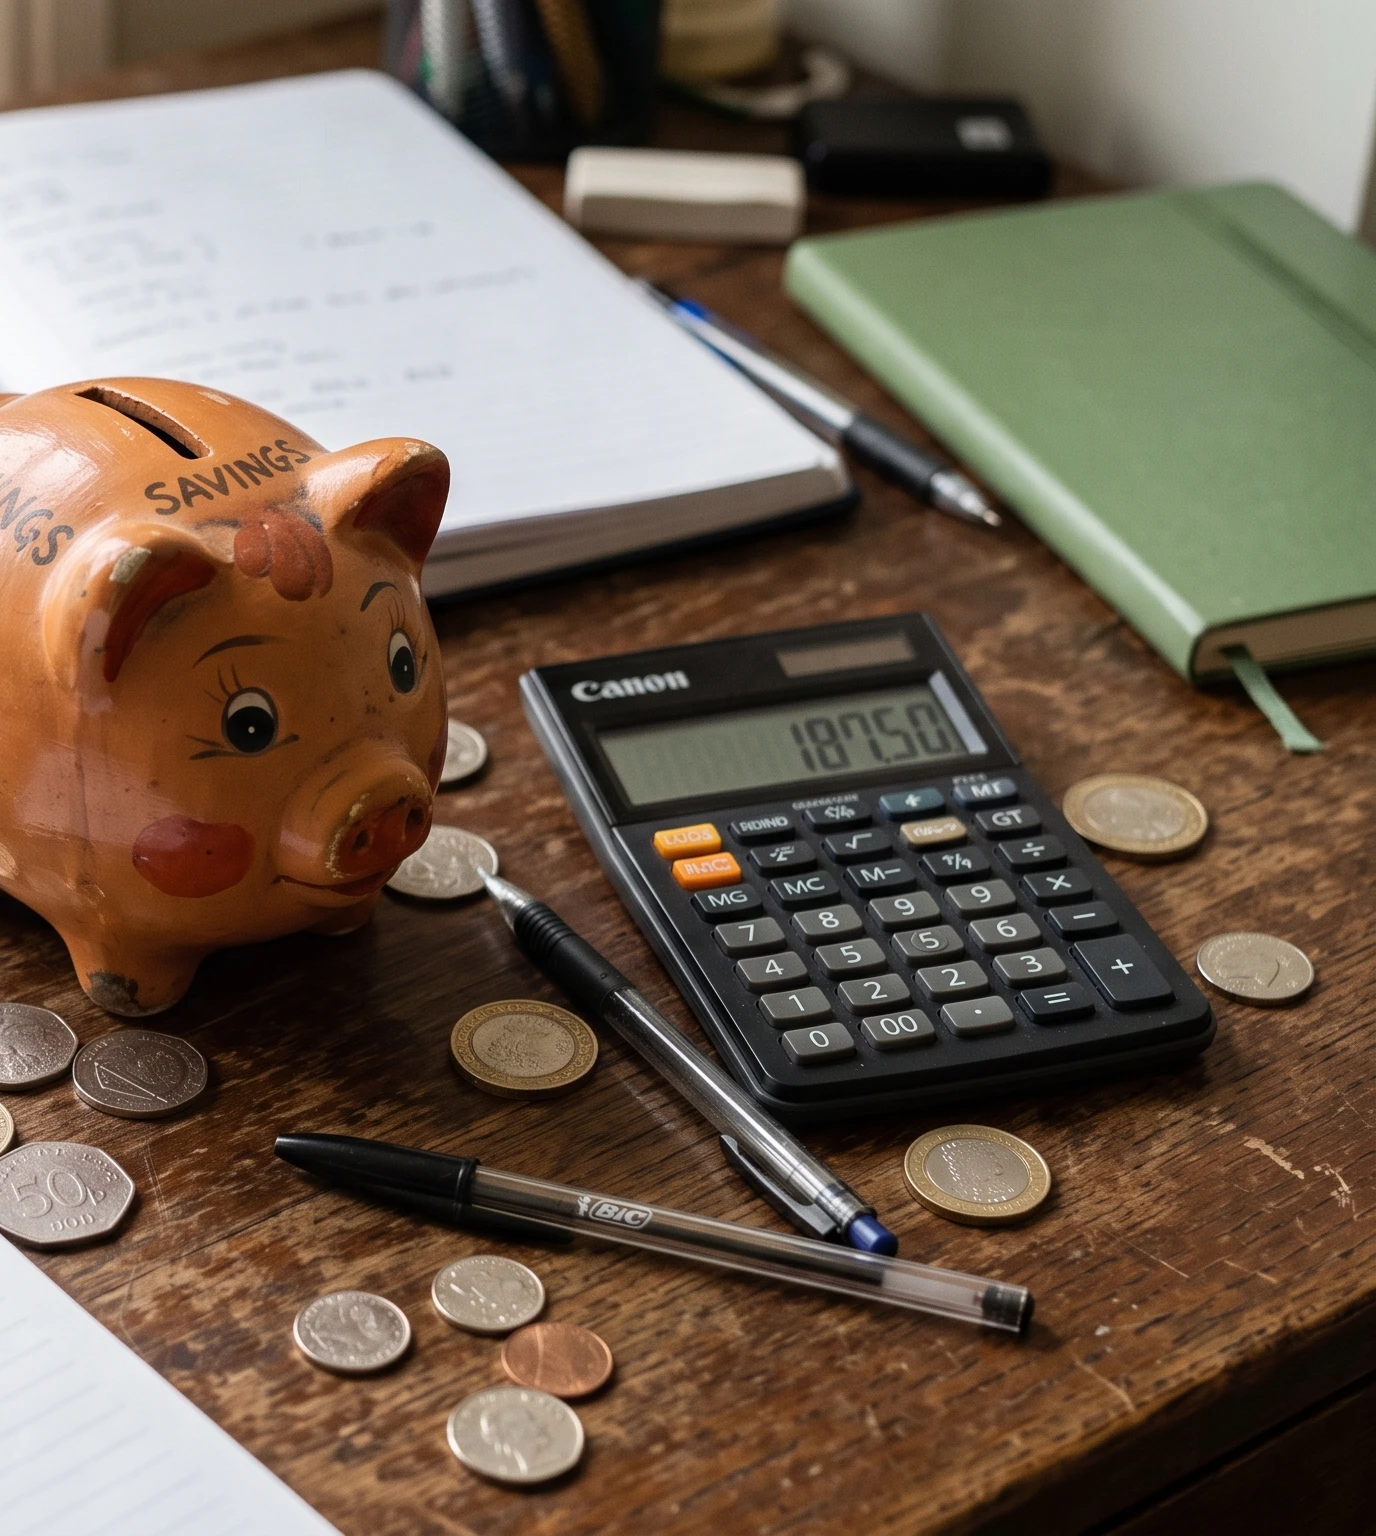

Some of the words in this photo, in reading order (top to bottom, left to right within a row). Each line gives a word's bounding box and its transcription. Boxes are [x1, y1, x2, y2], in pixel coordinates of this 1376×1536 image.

[144, 438, 312, 516] SAVINGS
[571, 669, 690, 703] Canon
[991, 808, 1023, 826] GT
[783, 876, 825, 895] MC
[970, 885, 992, 903] 9
[707, 890, 748, 908] MG
[894, 898, 916, 916] 9
[818, 911, 840, 929] 8
[996, 919, 1018, 938] 6
[738, 924, 756, 942] 7
[918, 931, 940, 949] 5
[840, 945, 862, 964] 5
[765, 959, 784, 976] 4
[1020, 955, 1043, 973] 3
[941, 968, 966, 987] 2
[863, 981, 888, 1000] 2
[788, 994, 806, 1012] 1
[879, 1014, 919, 1036] 00
[808, 1030, 830, 1048] 0
[594, 1203, 649, 1225] BIC
